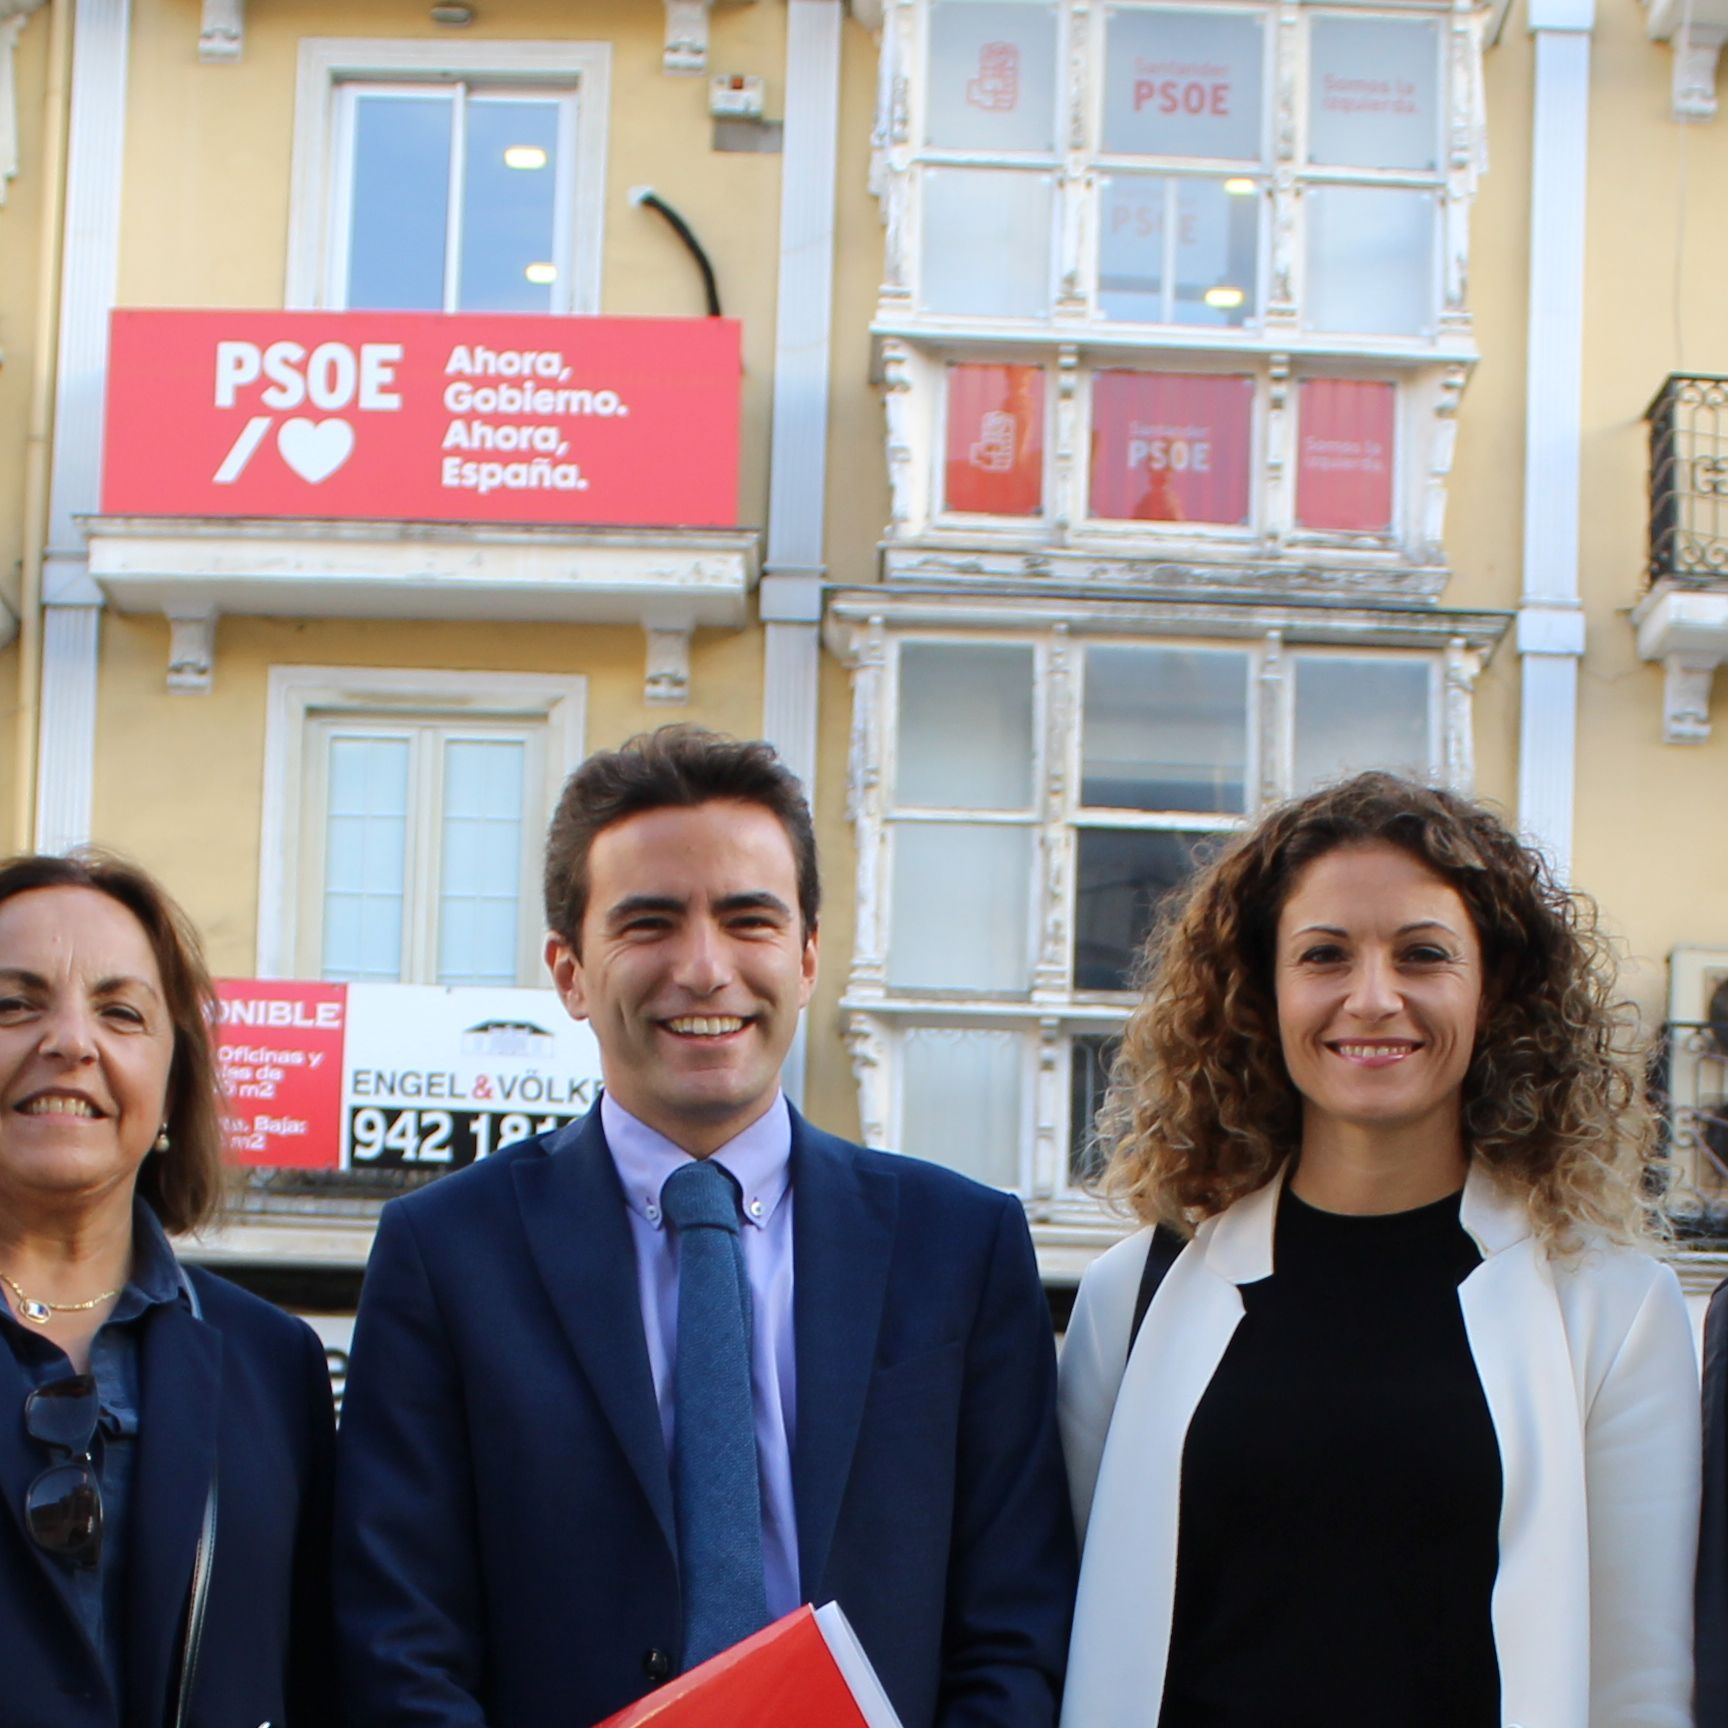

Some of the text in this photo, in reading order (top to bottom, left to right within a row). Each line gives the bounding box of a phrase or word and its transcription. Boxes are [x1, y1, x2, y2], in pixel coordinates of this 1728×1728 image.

[1133, 80, 1230, 116] PSOE
[214, 341, 403, 411] PSOE
[445, 345, 572, 382] Ahora,
[443, 381, 629, 416] Gobierno.
[441, 419, 569, 456] Ahora,
[1127, 440, 1211, 473] PSOE
[441, 457, 589, 494] España.
[202, 999, 342, 1029] ONIBLE
[217, 1045, 324, 1069] Oficinas y
[255, 1065, 285, 1082] de
[238, 1081, 277, 1098] m2
[253, 1115, 309, 1137] Baja:
[353, 1107, 454, 1163] 942
